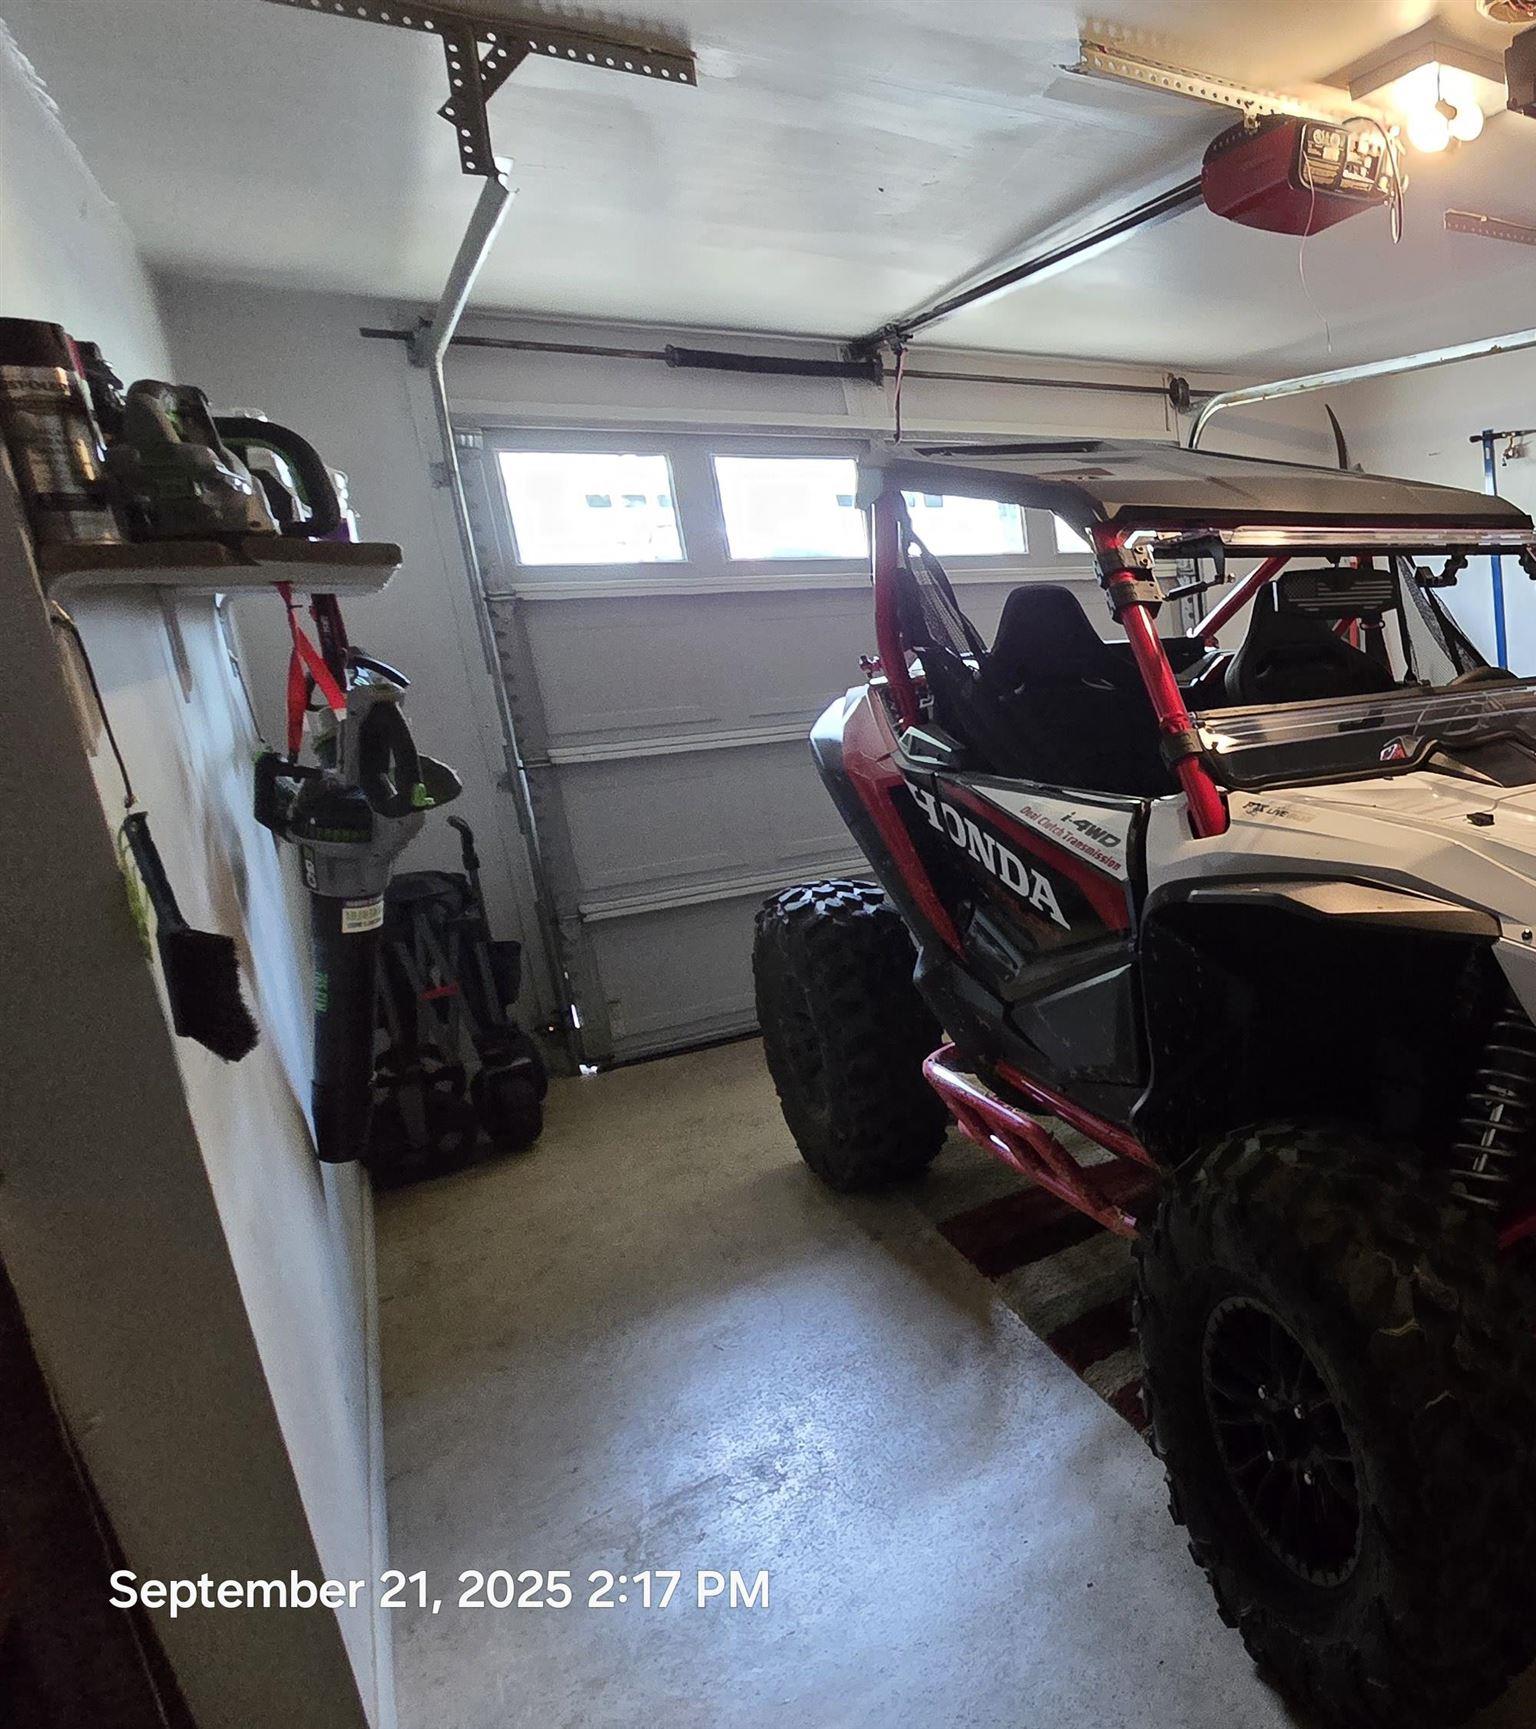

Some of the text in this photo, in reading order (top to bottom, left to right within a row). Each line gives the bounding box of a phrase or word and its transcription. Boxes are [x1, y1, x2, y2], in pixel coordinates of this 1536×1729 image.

[1060, 811, 1121, 848] i-4WD
[904, 779, 1071, 931] HONDA
[1062, 831, 1121, 870] Transmission
